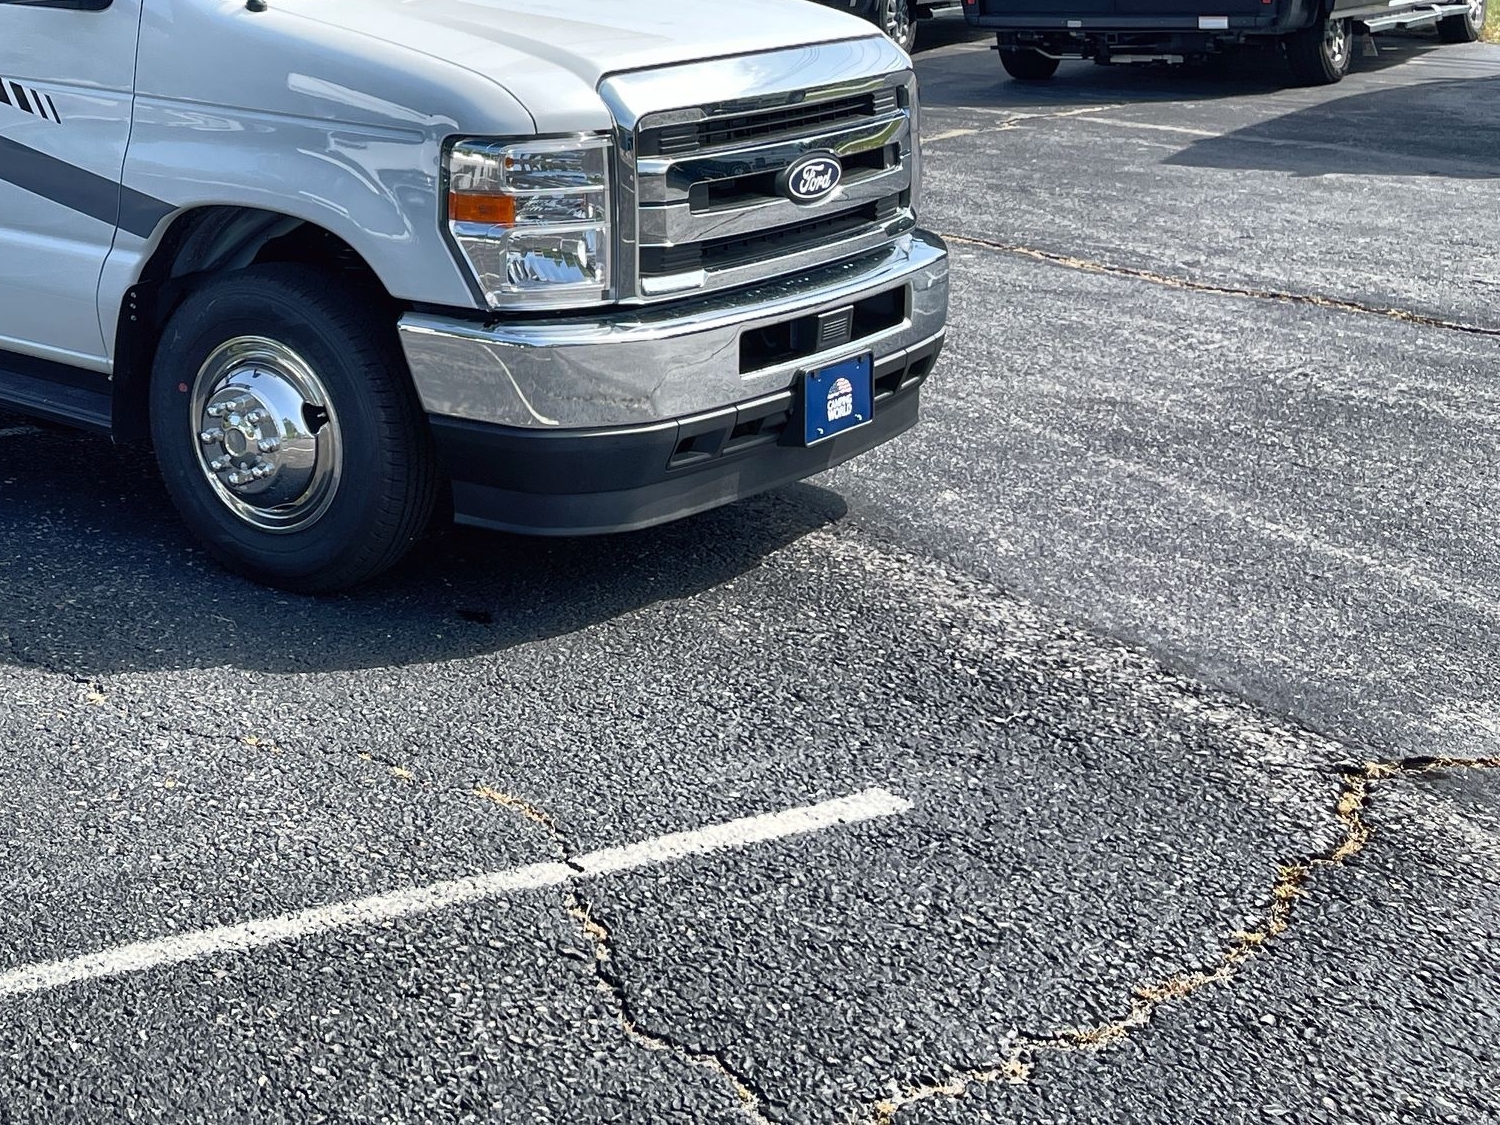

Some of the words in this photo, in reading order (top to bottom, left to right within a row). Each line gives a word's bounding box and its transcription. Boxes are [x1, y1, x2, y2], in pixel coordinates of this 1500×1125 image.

[799, 163, 833, 194] Ford
[827, 393, 853, 410] CAMPING
[827, 403, 853, 422] WORLD
